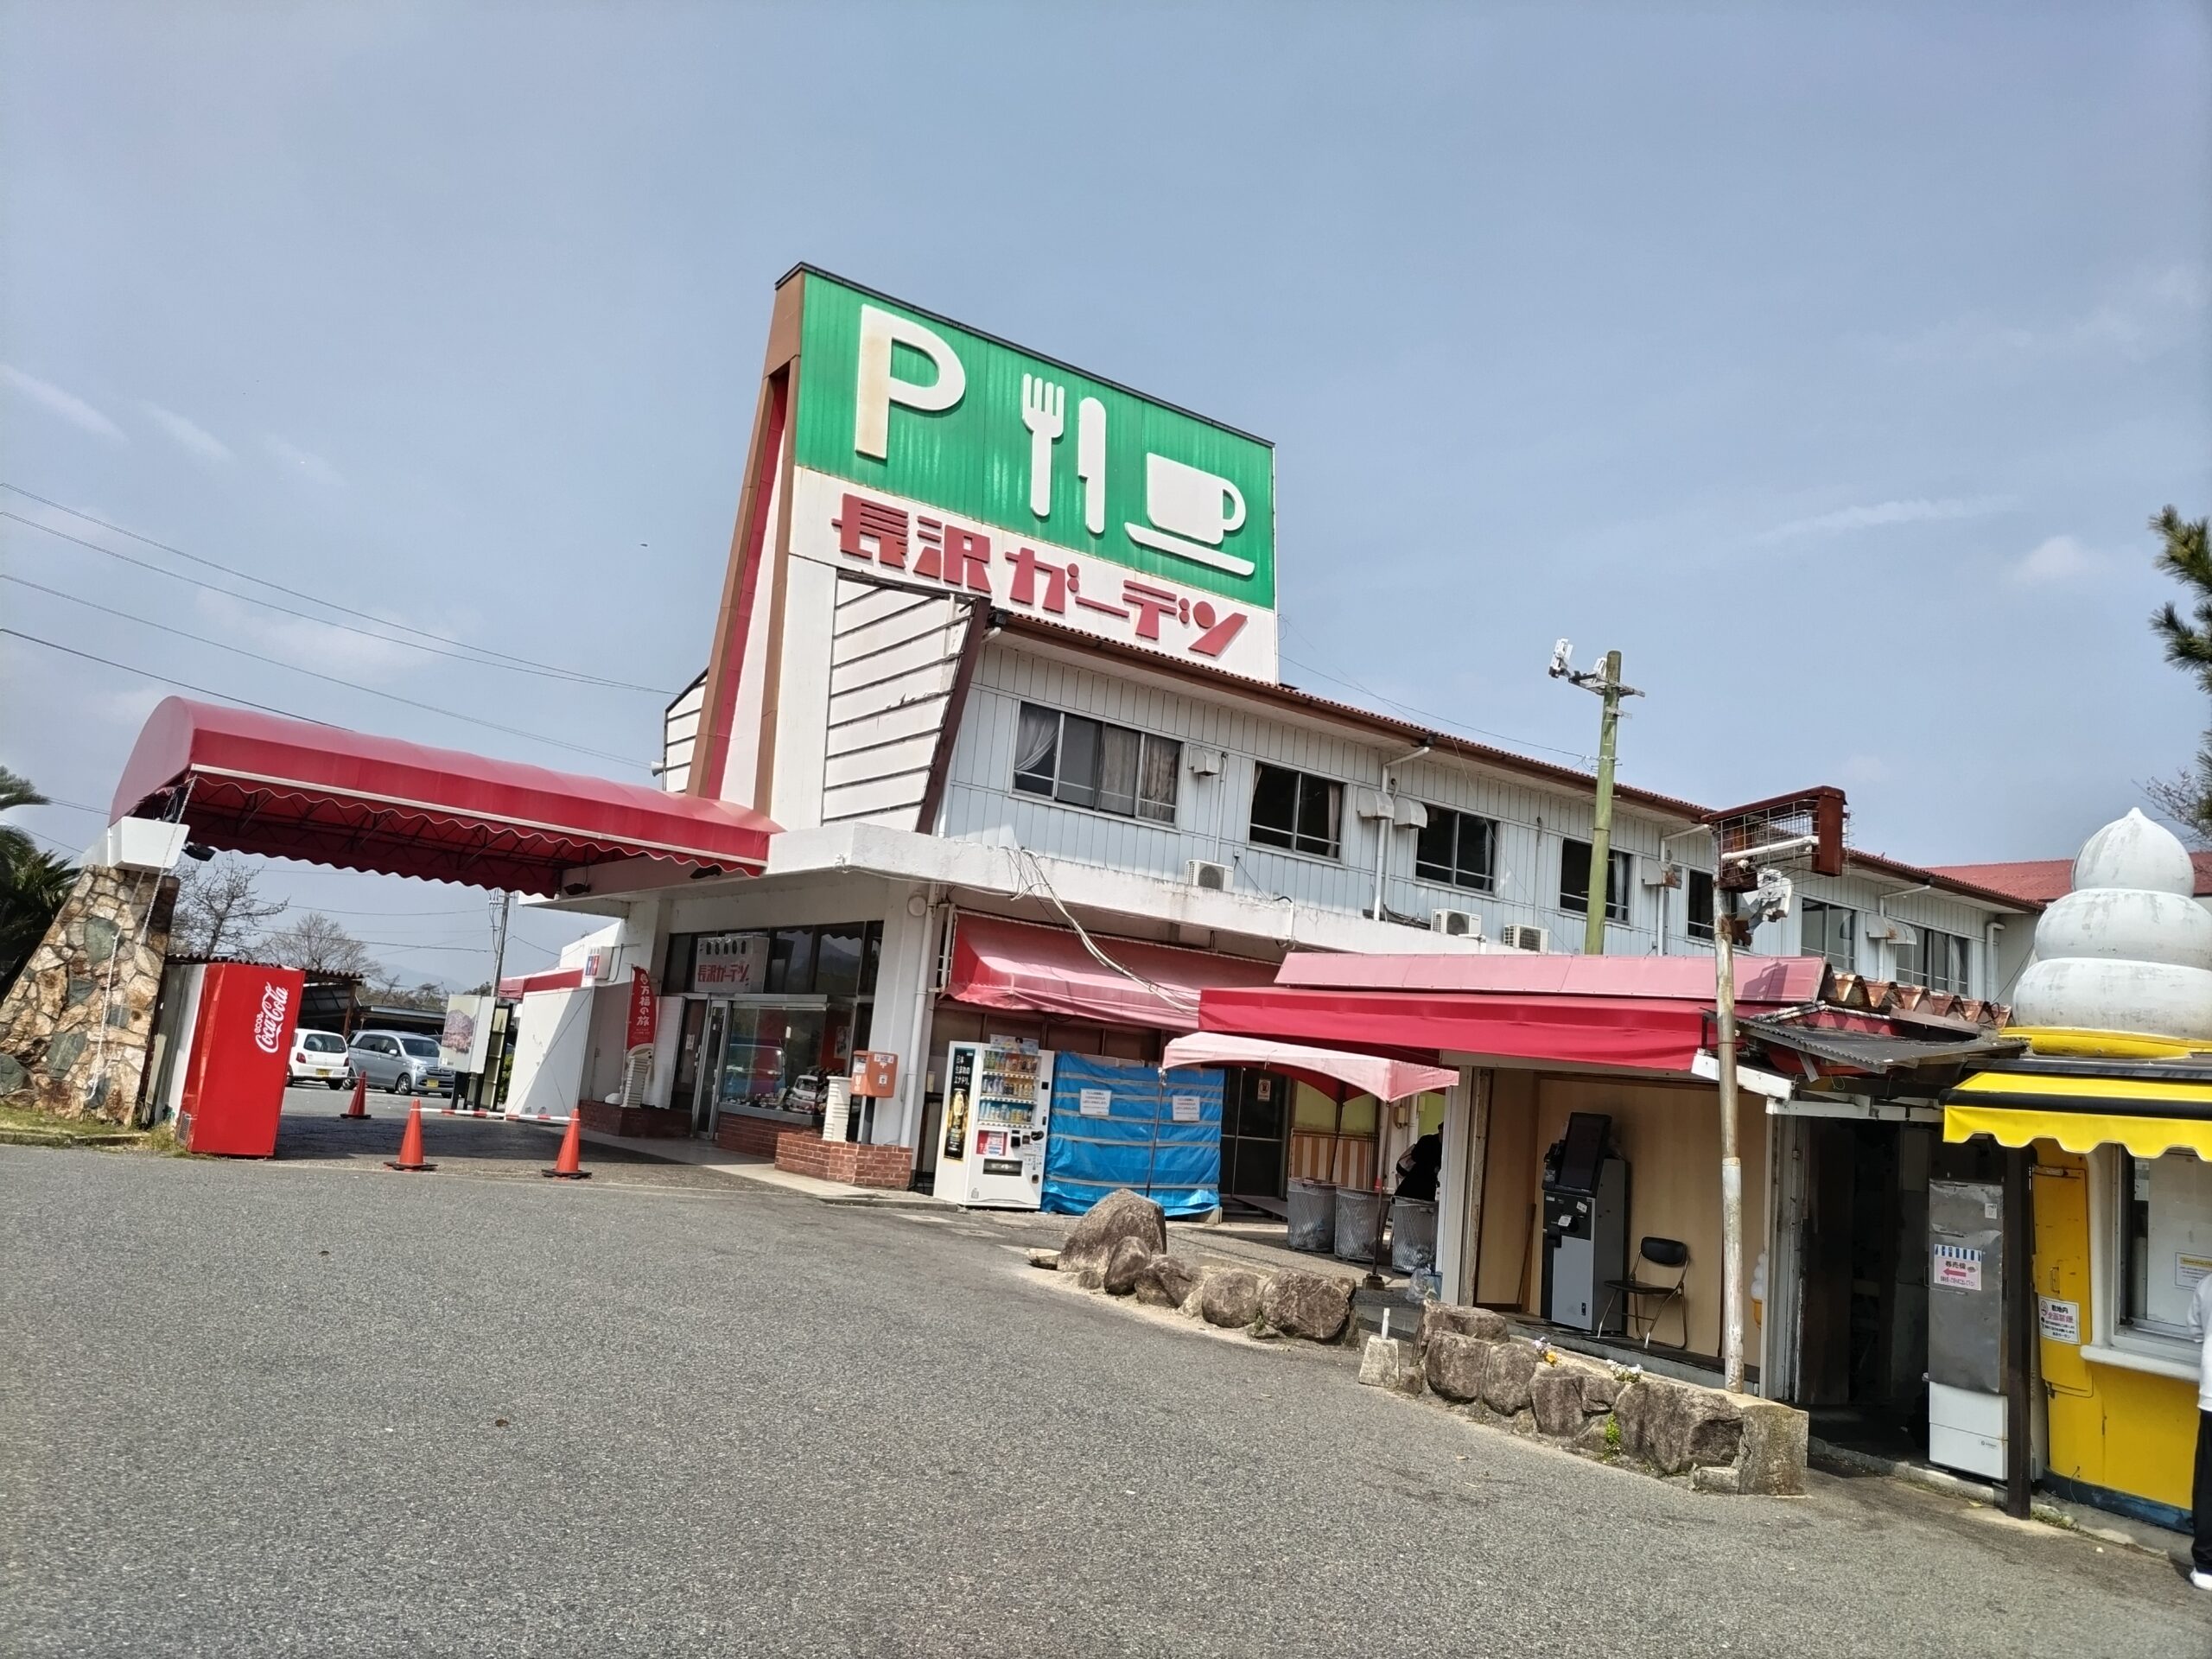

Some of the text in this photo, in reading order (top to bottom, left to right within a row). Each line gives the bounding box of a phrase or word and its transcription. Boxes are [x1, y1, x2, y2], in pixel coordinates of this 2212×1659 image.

[855, 303, 967, 461] P
[831, 493, 1248, 658] 長沢ガーデン
[636, 985, 651, 1027] 万福の旅
